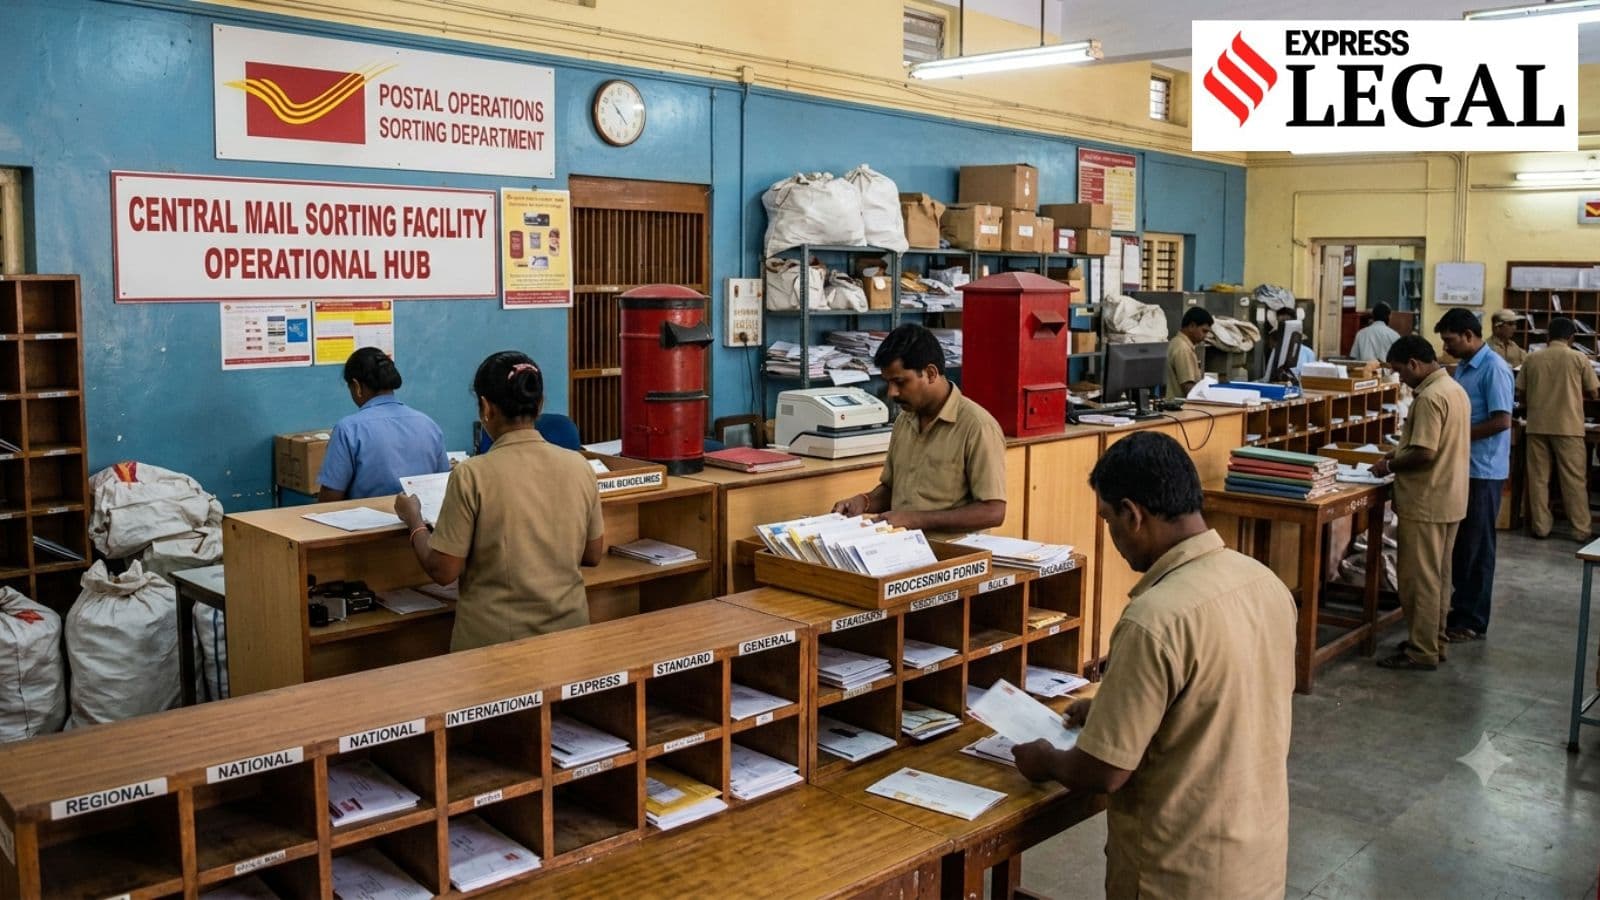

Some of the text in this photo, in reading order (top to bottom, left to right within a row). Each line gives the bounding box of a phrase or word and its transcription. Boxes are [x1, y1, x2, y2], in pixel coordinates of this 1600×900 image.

[379, 84, 545, 123] POSTAL OPERATIONS
[379, 116, 545, 152] SORTING DEPARTMENT
[128, 196, 487, 240] CENTRAL MAIL SORTING FACILITY
[204, 247, 431, 281] OPERATIONAL HUB
[887, 570, 951, 596] PROCESSING
[743, 633, 793, 654] GENERAL
[446, 693, 542, 726] INTERNATIONAL
[349, 722, 418, 749] NATIONAL
[217, 751, 294, 780] NATIONAL
[65, 783, 155, 816] REGIONAL
